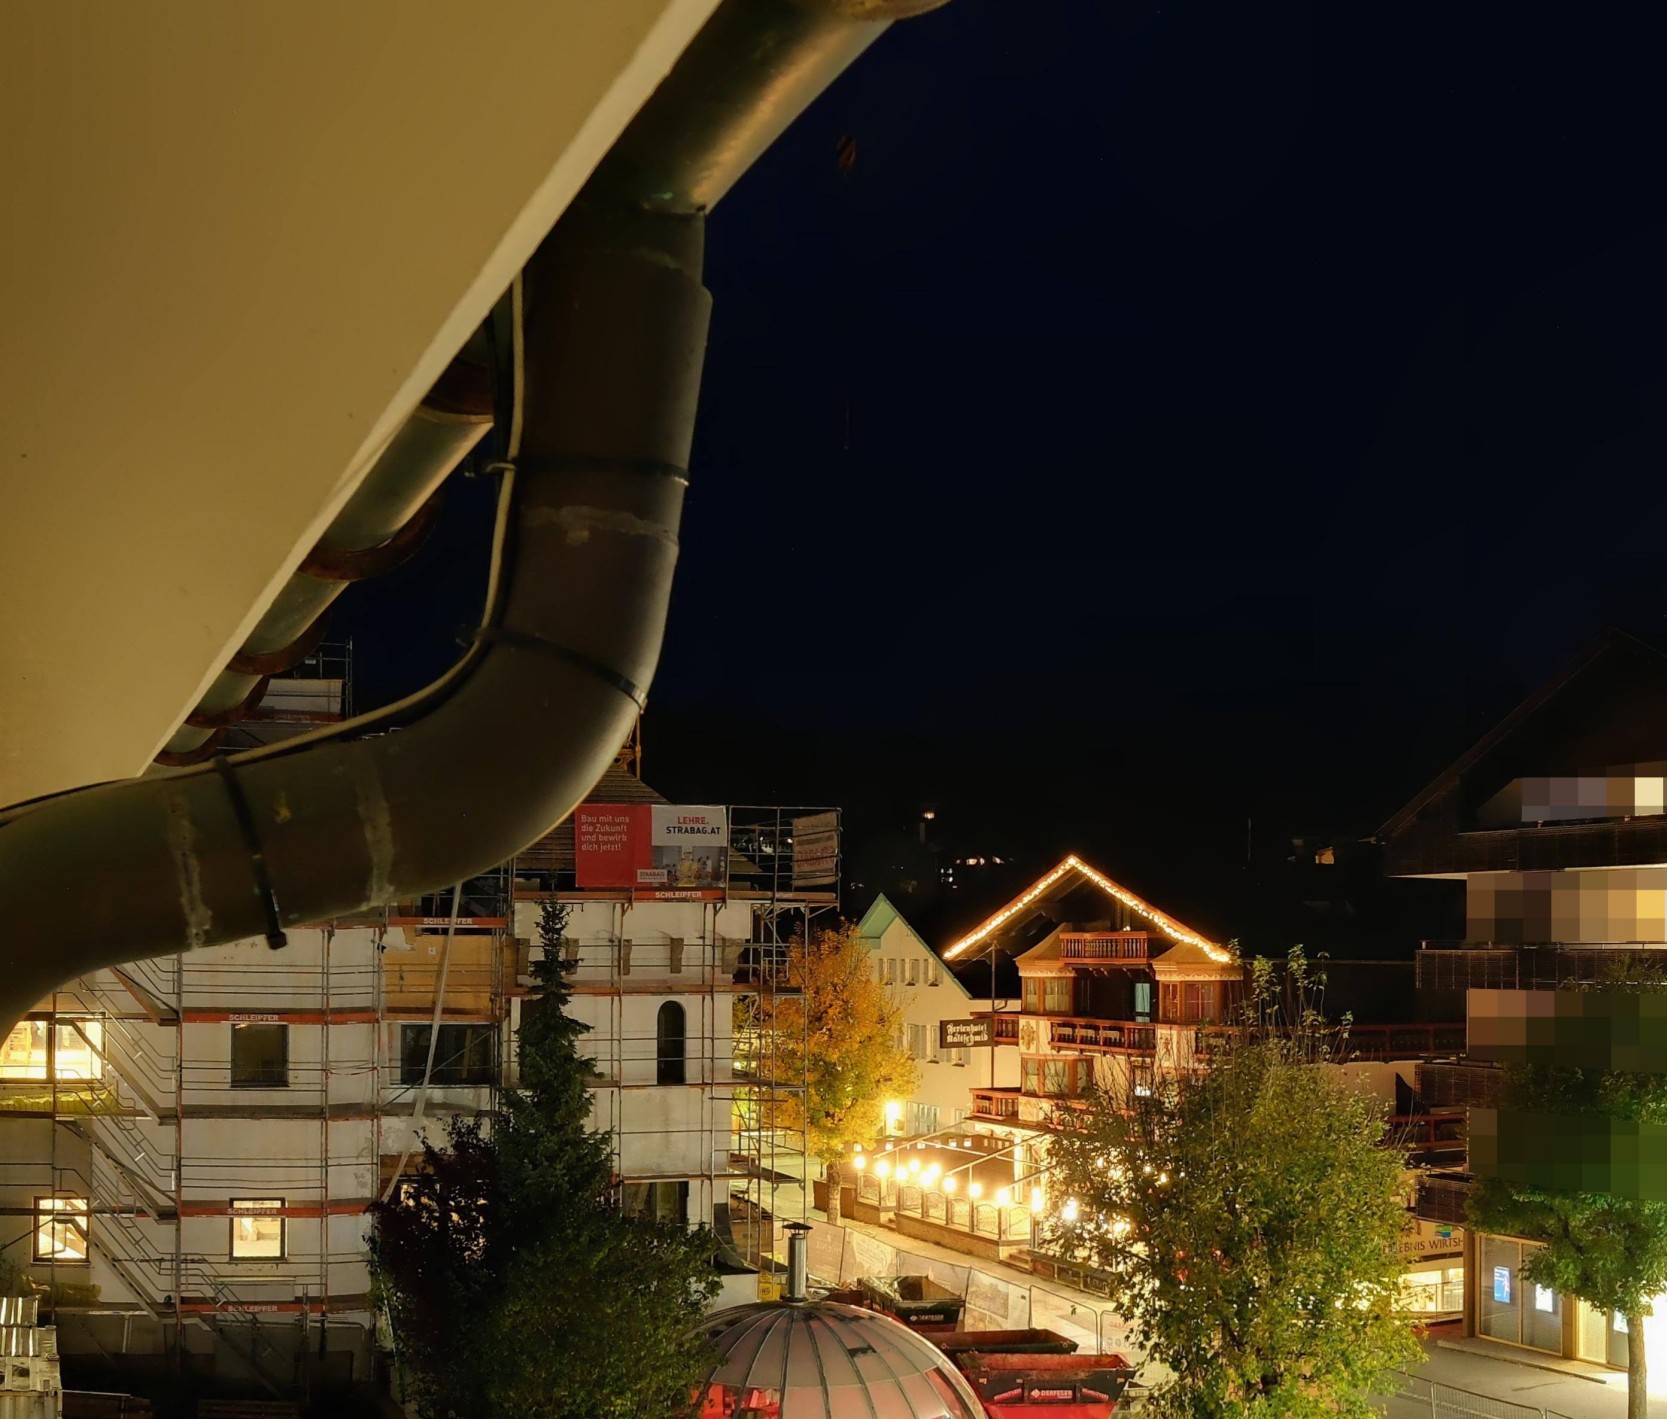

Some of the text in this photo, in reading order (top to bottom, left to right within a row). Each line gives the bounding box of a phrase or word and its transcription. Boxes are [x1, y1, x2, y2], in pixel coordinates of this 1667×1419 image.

[581, 815, 595, 823] Bau
[598, 815, 611, 823] mit
[581, 824, 627, 832] die Zukunft
[666, 827, 720, 835] STRABAG.AT
[581, 833, 627, 842] und bewirb
[581, 843, 621, 852] dich jetzt!
[423, 917, 472, 925] SCHLEPFER
[229, 1014, 279, 1022] SCHLEIPFER
